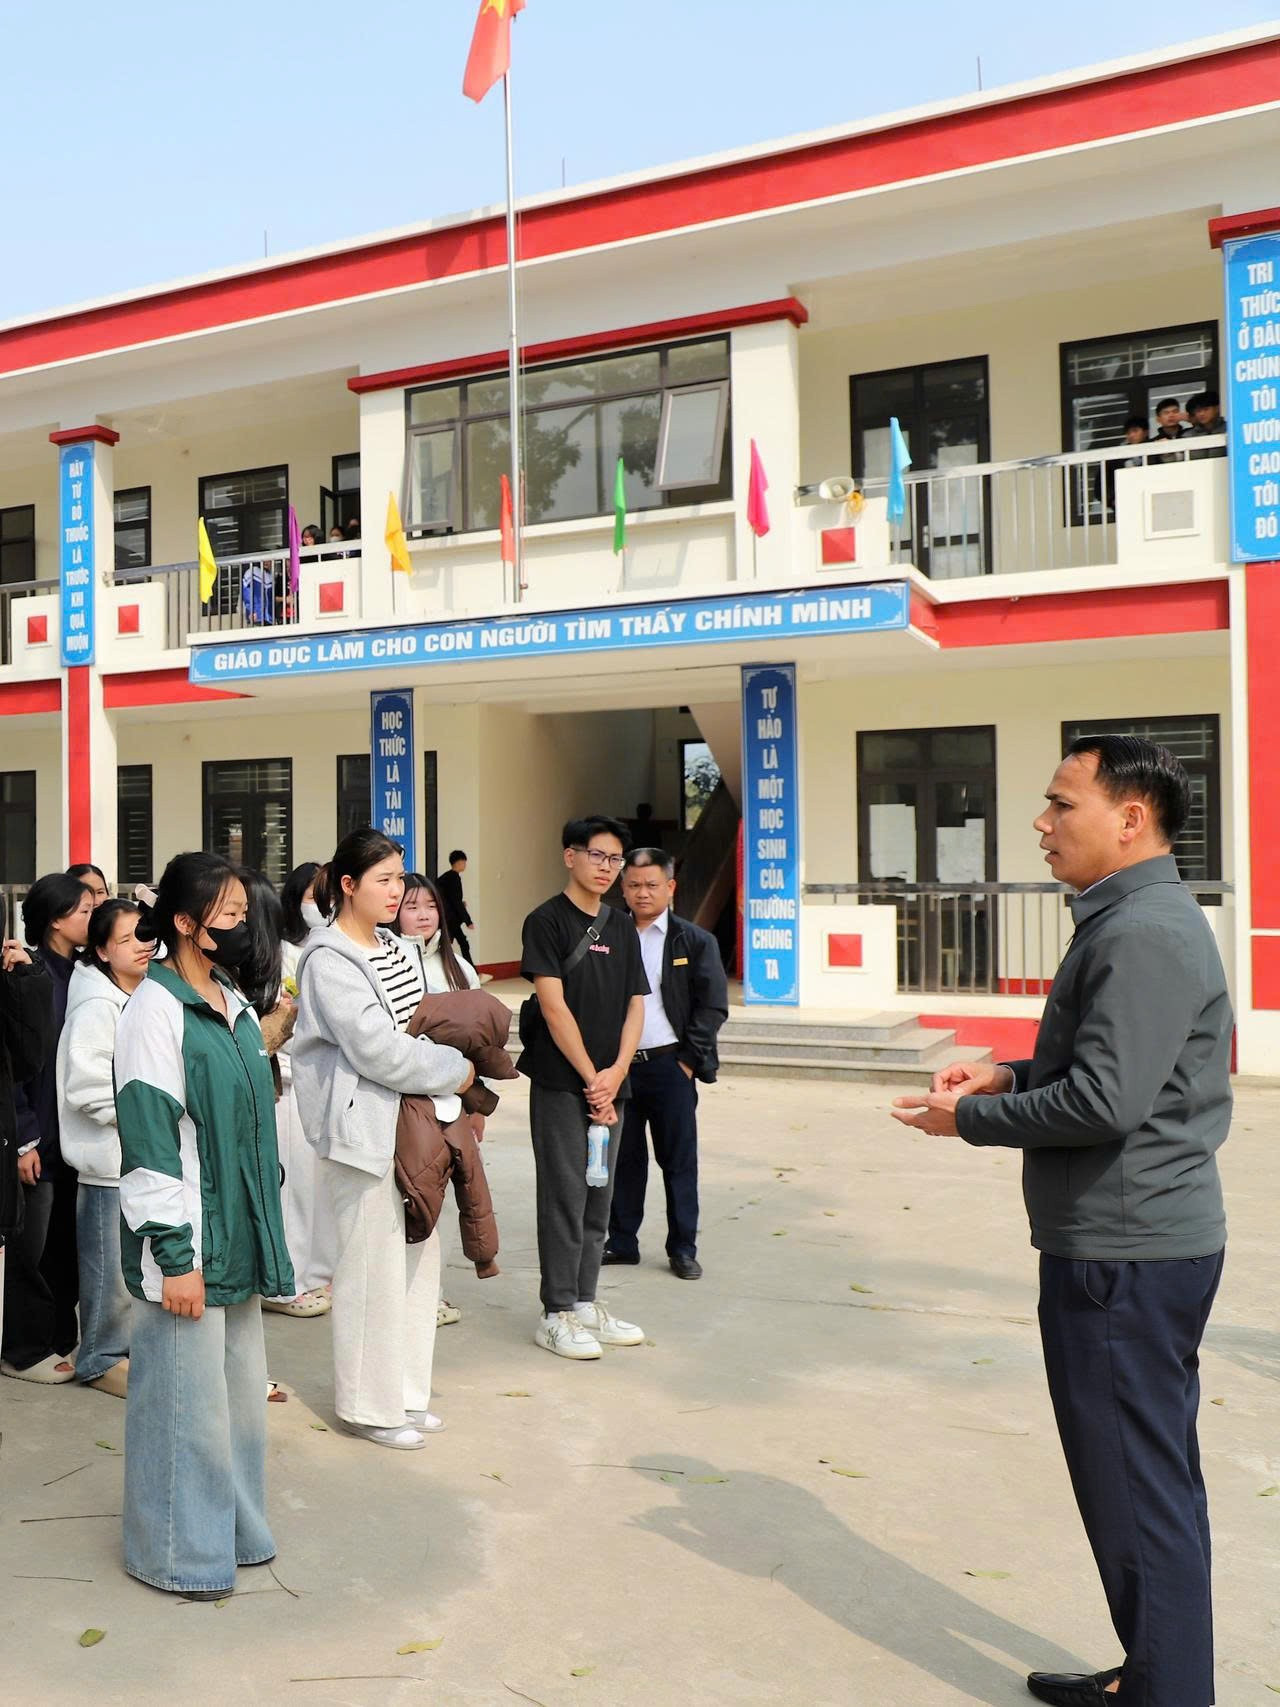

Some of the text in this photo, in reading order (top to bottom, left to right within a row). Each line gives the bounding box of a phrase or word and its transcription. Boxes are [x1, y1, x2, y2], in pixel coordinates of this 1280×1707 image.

[1248, 261, 1273, 286] TRI
[1238, 322, 1250, 350] Ở
[1235, 353, 1280, 382] CHÚN
[1251, 384, 1277, 412] TÔI
[1253, 480, 1278, 507] TỚI
[1255, 512, 1278, 539] ĐÓ
[214, 597, 872, 671] GIÁO DỤC LÀM CHO CON NGƯỜI TÌM THẤY CHÍNH MÌNH
[761, 686, 778, 713] TỰ
[381, 711, 403, 734] HỌC
[757, 714, 782, 739] HÀO
[379, 734, 406, 757] THỨC
[763, 744, 778, 769] LÀ
[386, 761, 400, 783] LÀ
[385, 788, 402, 810] TÀI
[758, 774, 784, 804] MỘT
[383, 812, 405, 837] SẢN
[759, 808, 784, 834] HỌC
[757, 838, 787, 860] SINH
[760, 862, 784, 890] CỦA
[750, 894, 795, 920] TRƯỜNG
[752, 925, 793, 950] CHÚNG
[764, 959, 780, 980] TA
